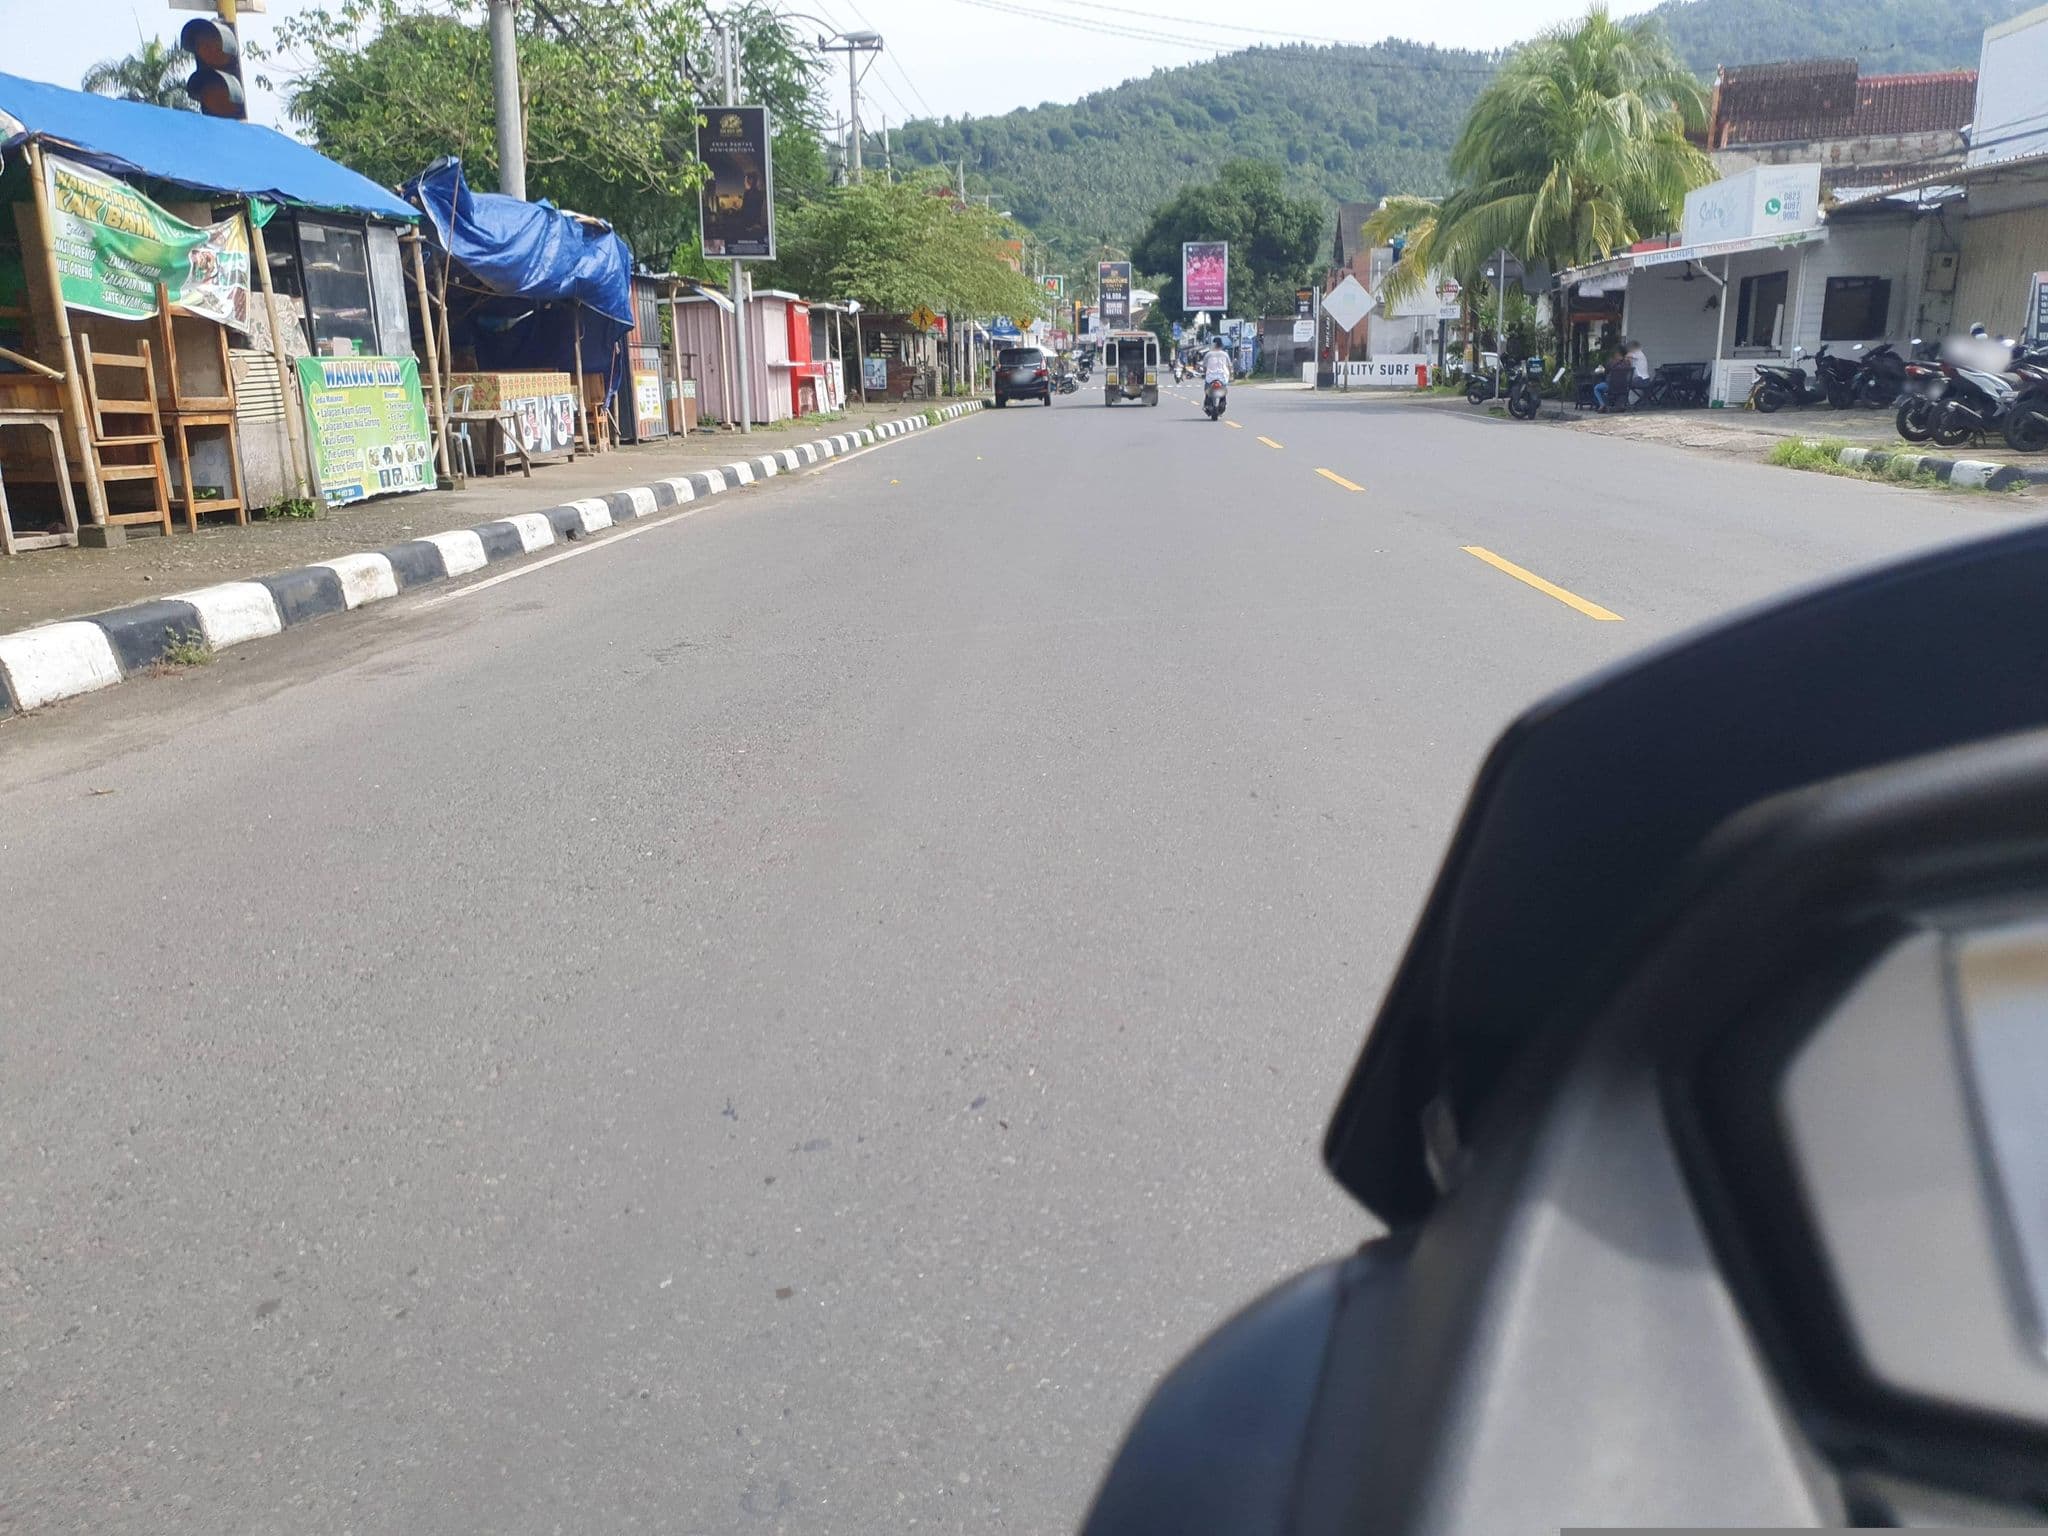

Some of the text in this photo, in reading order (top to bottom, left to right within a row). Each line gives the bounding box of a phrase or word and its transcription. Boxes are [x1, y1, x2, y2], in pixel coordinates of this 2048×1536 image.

[55, 168, 114, 203] WARUNG
[55, 186, 103, 223] KAK
[321, 361, 404, 388] WARUNG KITA
[1336, 364, 1374, 375] UALITY
[1380, 364, 1409, 375] SURF
